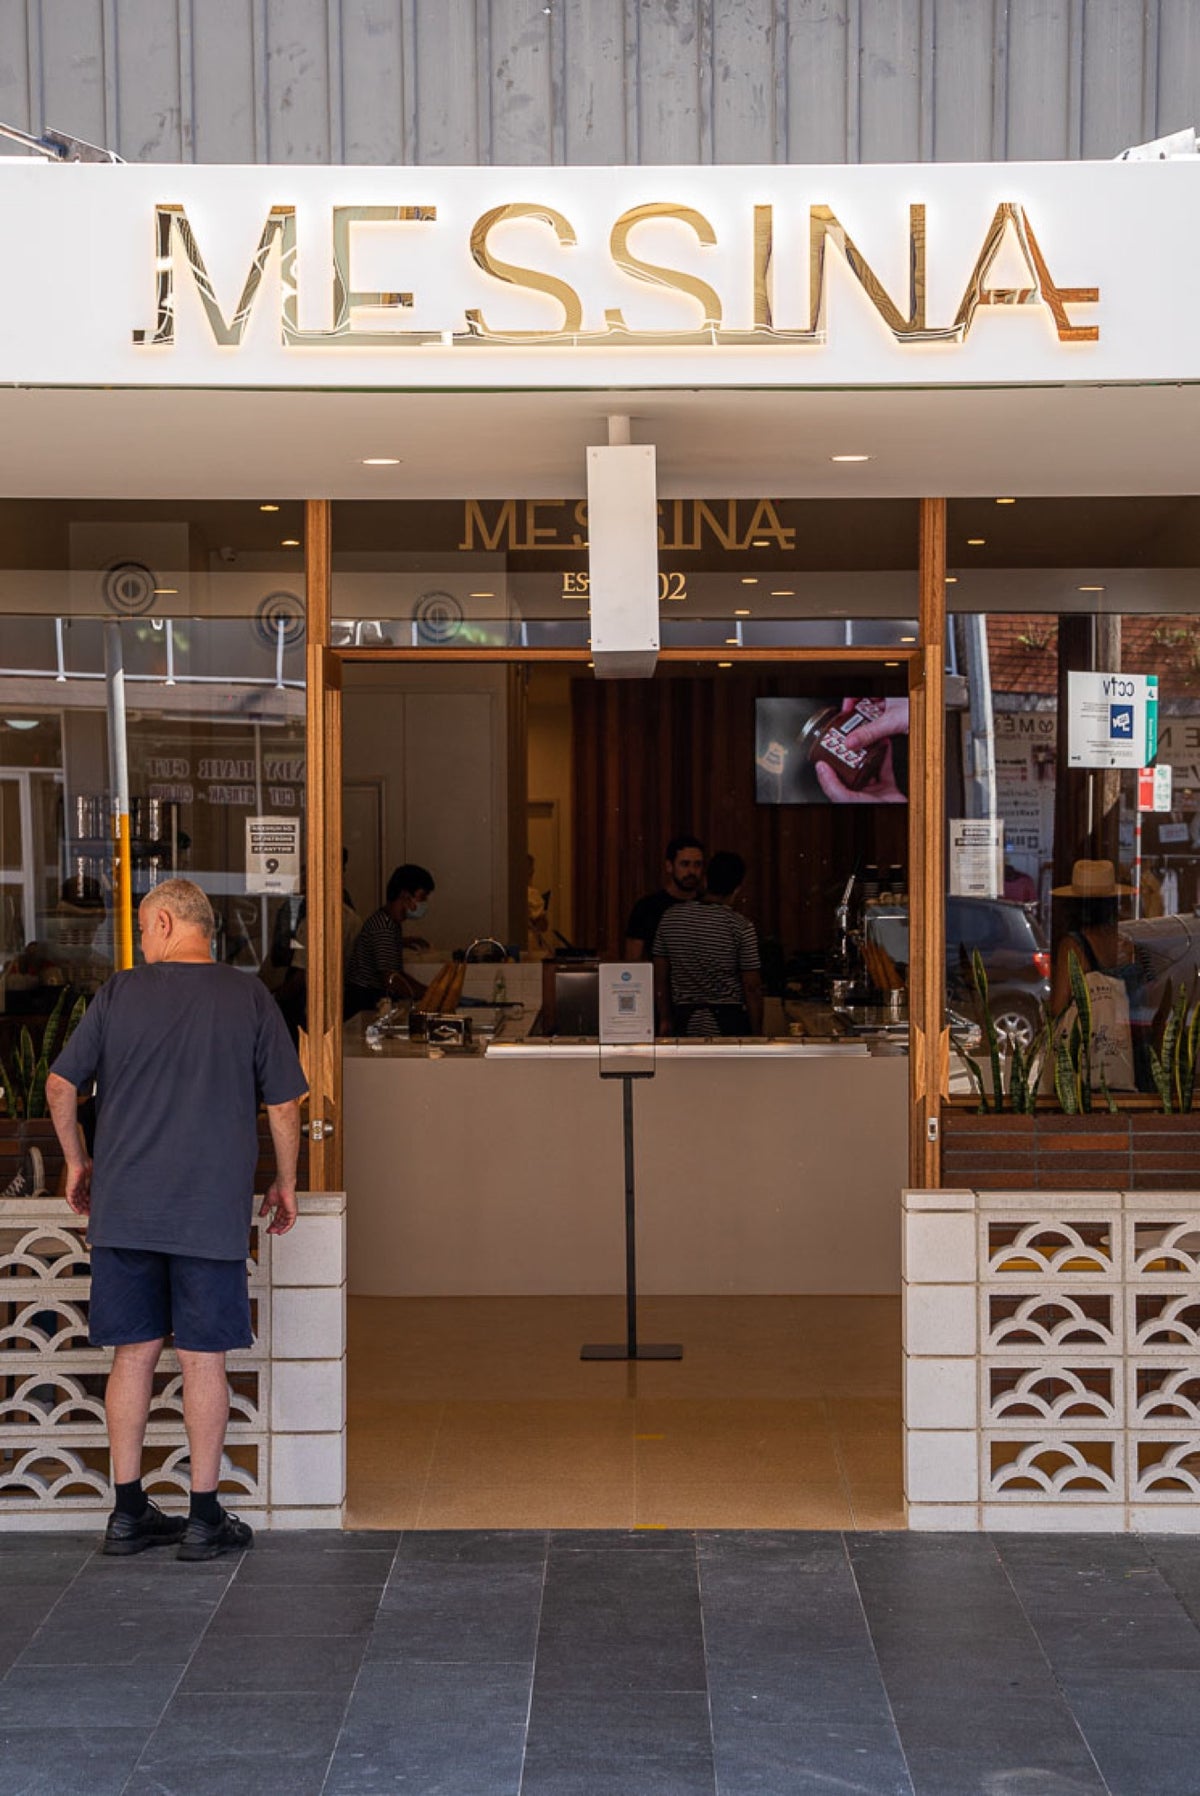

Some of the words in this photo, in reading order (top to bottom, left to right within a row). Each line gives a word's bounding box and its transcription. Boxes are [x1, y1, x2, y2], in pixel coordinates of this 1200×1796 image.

[131, 203, 1100, 346] MESSINA
[562, 572, 590, 593] ES
[265, 858, 279, 874] 9
